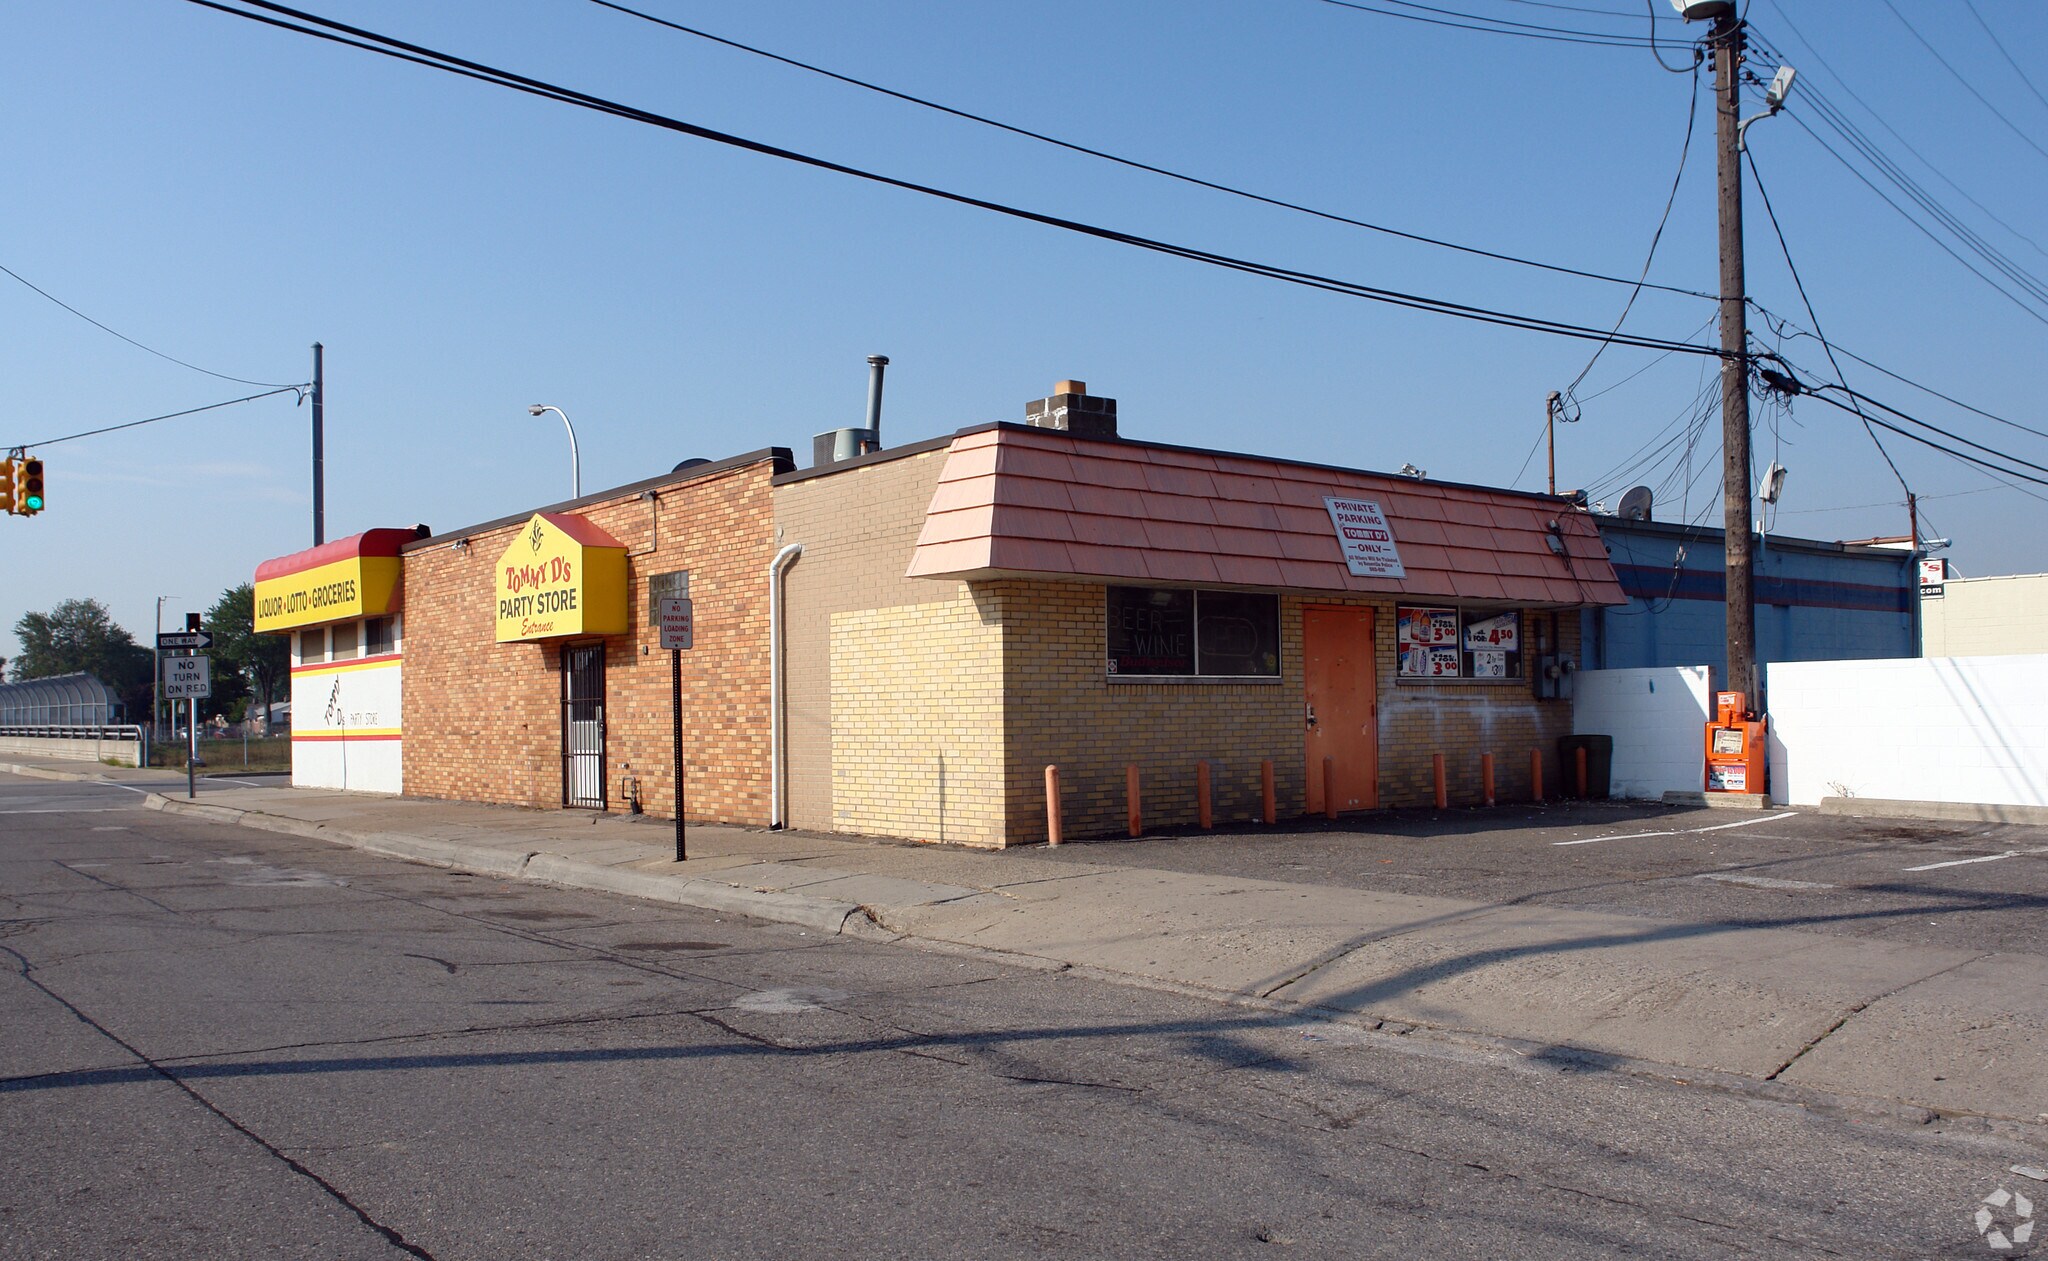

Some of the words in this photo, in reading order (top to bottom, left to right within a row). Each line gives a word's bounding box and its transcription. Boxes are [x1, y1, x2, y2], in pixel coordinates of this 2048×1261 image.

[1334, 502, 1376, 513] PRIVATE
[1337, 513, 1382, 525] PARKING
[1345, 529, 1374, 538] TOMMY
[1358, 544, 1381, 553] ONLY
[506, 561, 547, 593] TOMMY
[258, 596, 282, 619] LIQUOR
[287, 591, 308, 614] LOTTO
[312, 579, 356, 609] GROCERIES
[500, 595, 534, 619] PARTY
[537, 588, 577, 614] STORE
[1109, 606, 1163, 631] BEER
[521, 618, 554, 636] Entrance
[162, 637, 179, 645] ONE
[1134, 634, 1187, 656] WINE
[178, 661, 195, 670] NO
[173, 673, 200, 682] TURN
[168, 685, 182, 693] ON
[186, 684, 207, 693] RED
